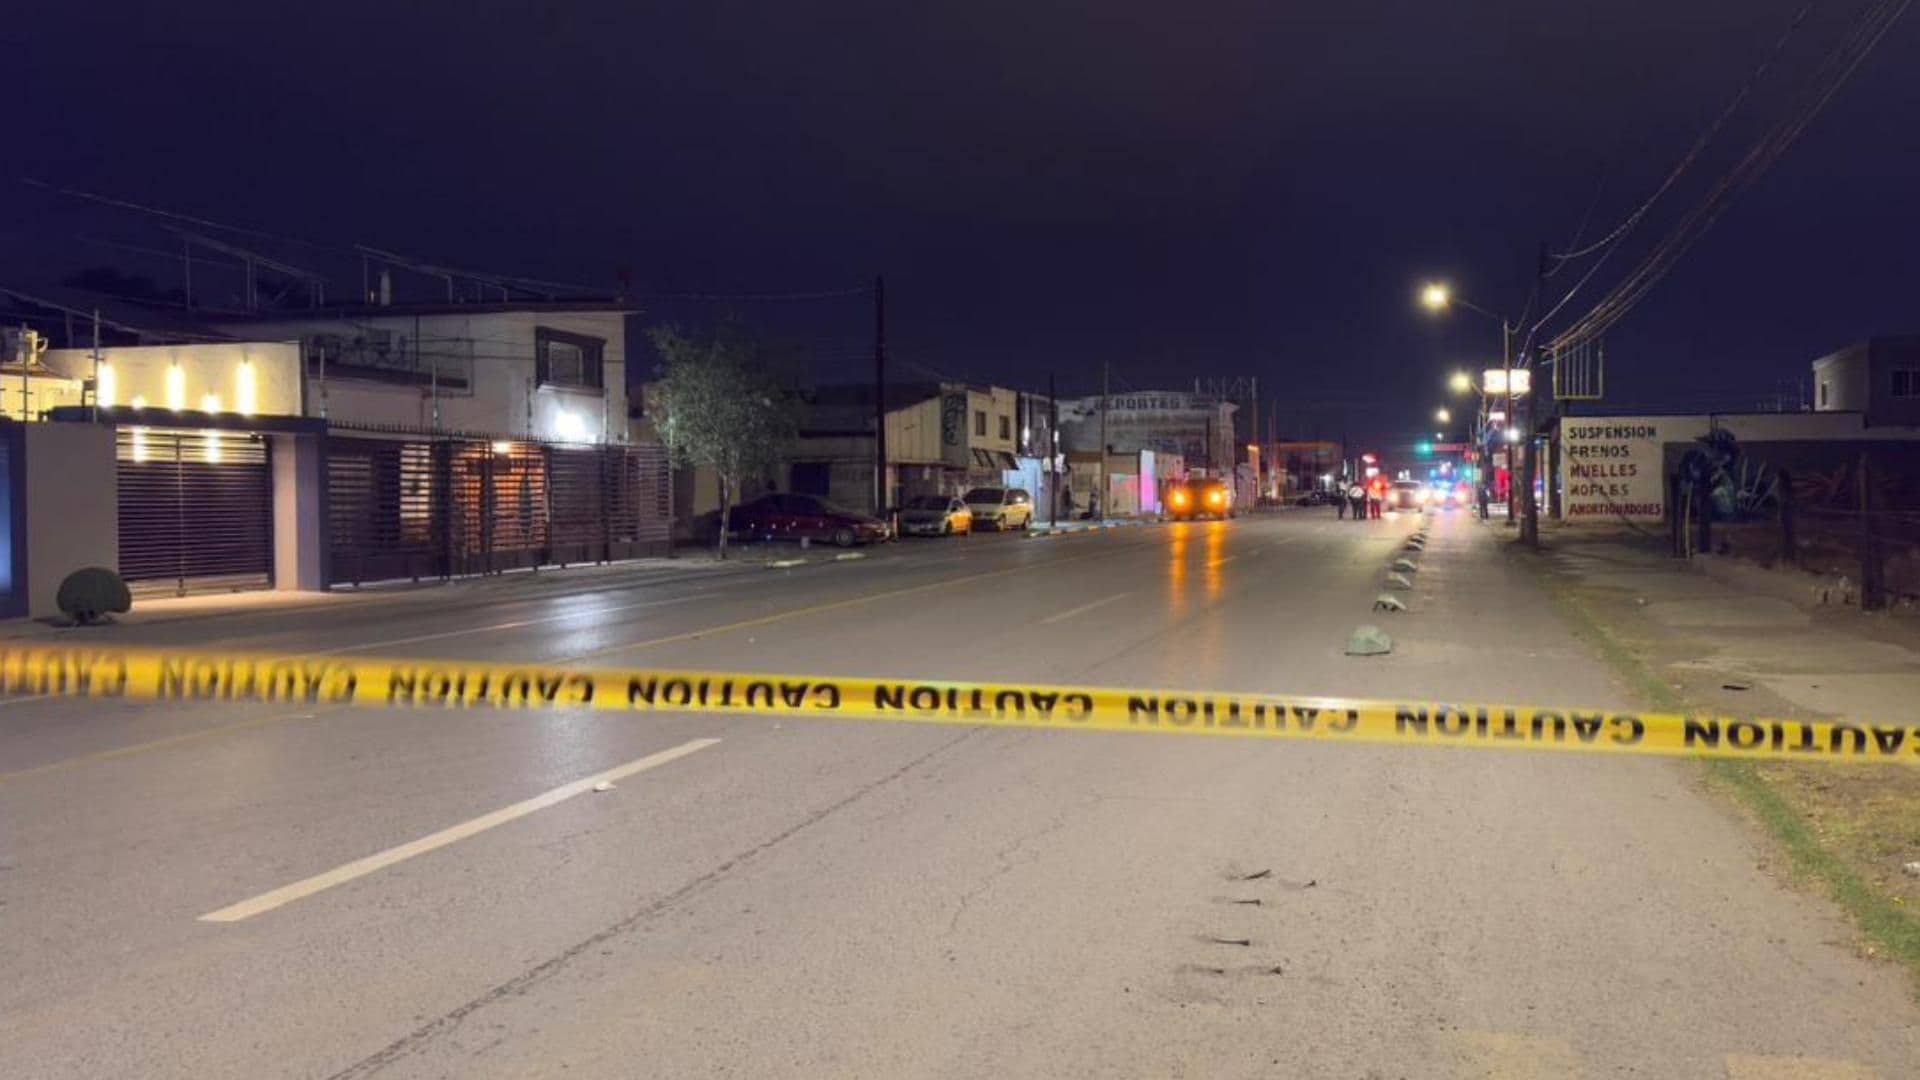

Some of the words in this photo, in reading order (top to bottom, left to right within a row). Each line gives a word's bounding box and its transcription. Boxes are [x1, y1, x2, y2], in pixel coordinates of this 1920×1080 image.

[1569, 426, 1656, 439] SUSPENSION
[1570, 445, 1630, 458] FRENOS
[1570, 463, 1637, 478] MUELLES
[387, 671, 594, 706] CAUTION
[627, 678, 841, 709] CAUTION
[873, 684, 1092, 721] CAUTION
[1127, 697, 1358, 732] CAUTION
[1394, 706, 1645, 745] CAUTION
